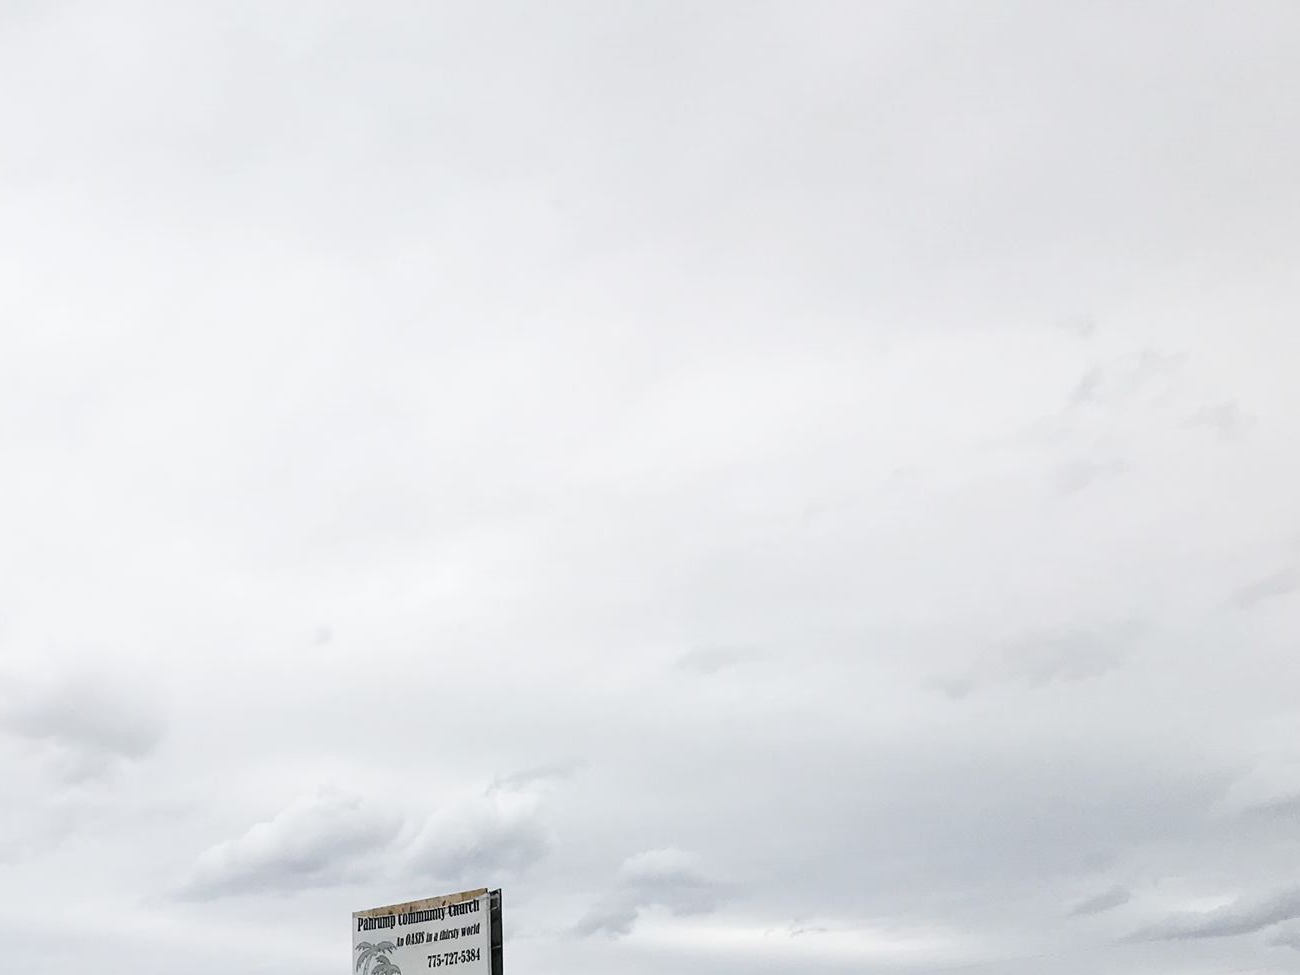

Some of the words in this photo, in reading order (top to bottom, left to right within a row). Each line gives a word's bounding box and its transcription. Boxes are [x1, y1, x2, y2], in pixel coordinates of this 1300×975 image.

[447, 899, 480, 917] Church
[405, 931, 425, 945] OASIS
[439, 928, 459, 941] thirsty
[460, 922, 480, 937] world
[427, 947, 481, 968] 775-727-5384
